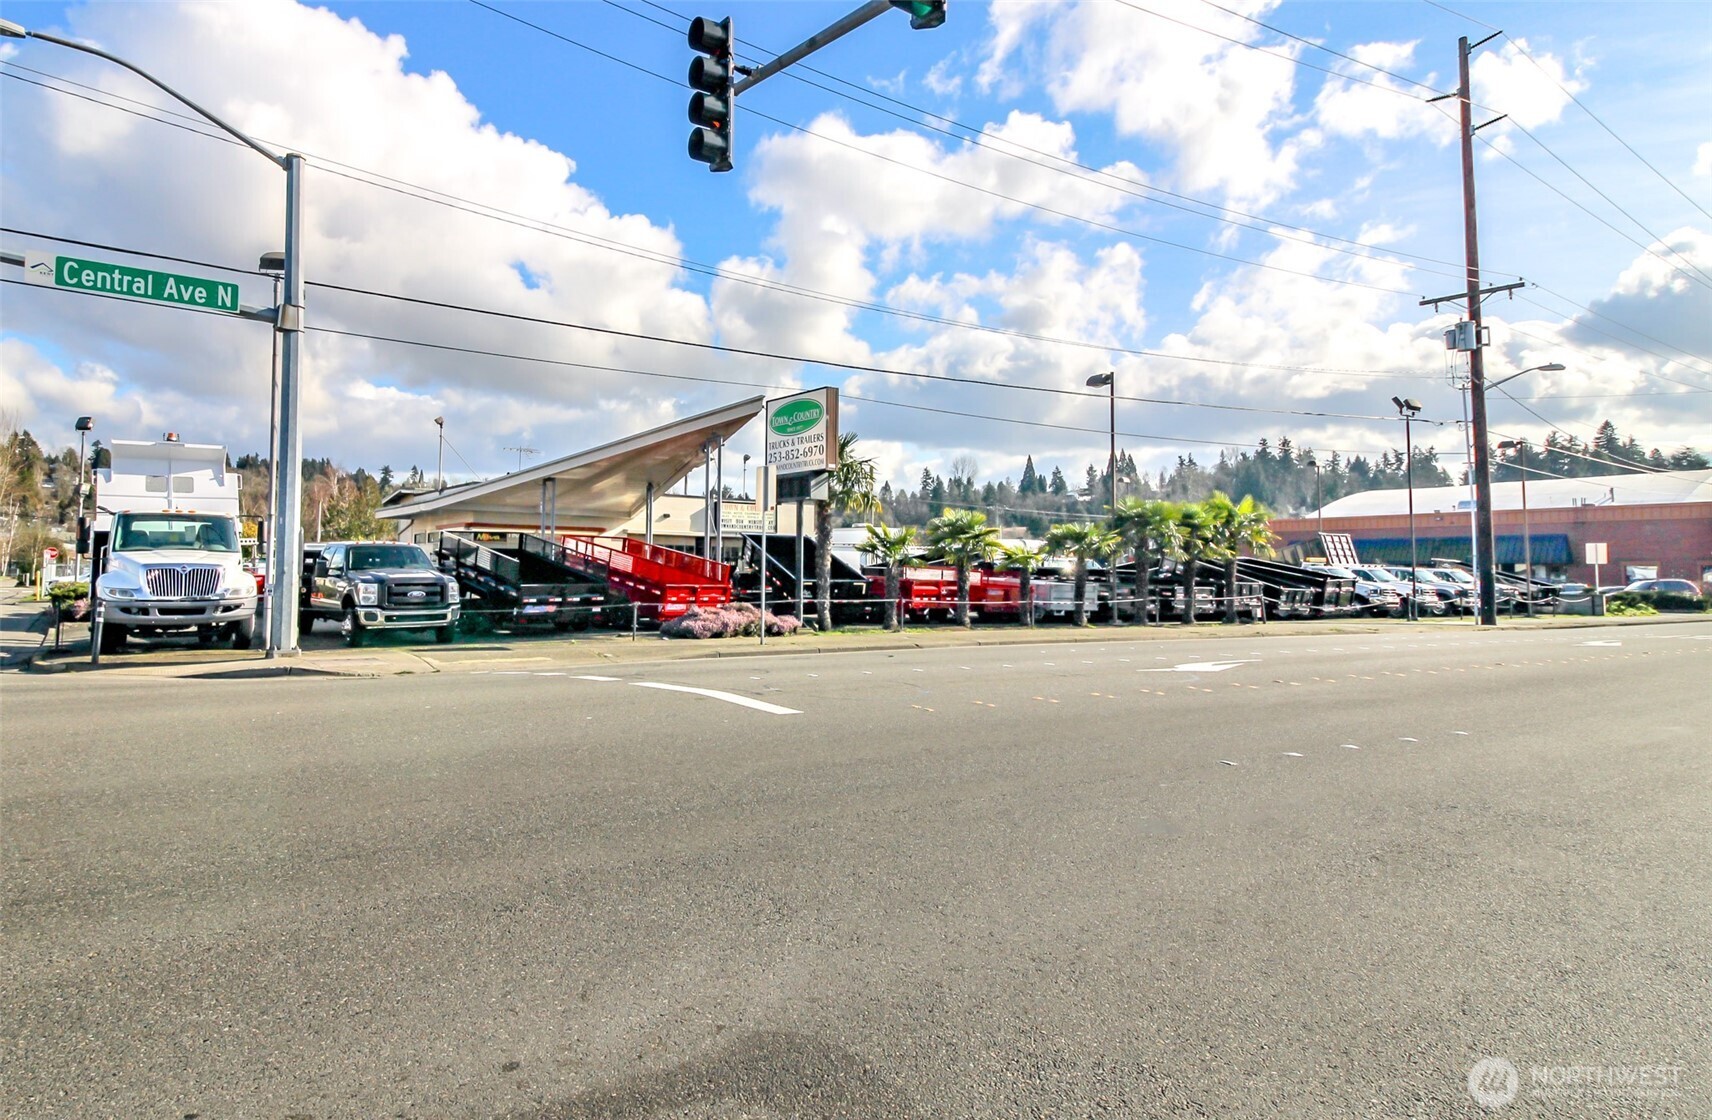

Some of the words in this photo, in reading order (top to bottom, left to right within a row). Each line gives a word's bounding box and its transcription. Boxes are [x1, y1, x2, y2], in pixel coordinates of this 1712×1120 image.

[63, 261, 153, 296] Central
[163, 277, 208, 303] Ave
[217, 285, 232, 308] N
[772, 416, 788, 426] TOWN
[793, 409, 820, 421] COUNTRY
[769, 440, 789, 450] TRUCKS
[797, 433, 824, 445] TRAILERS
[768, 444, 825, 464] 253-852-6970
